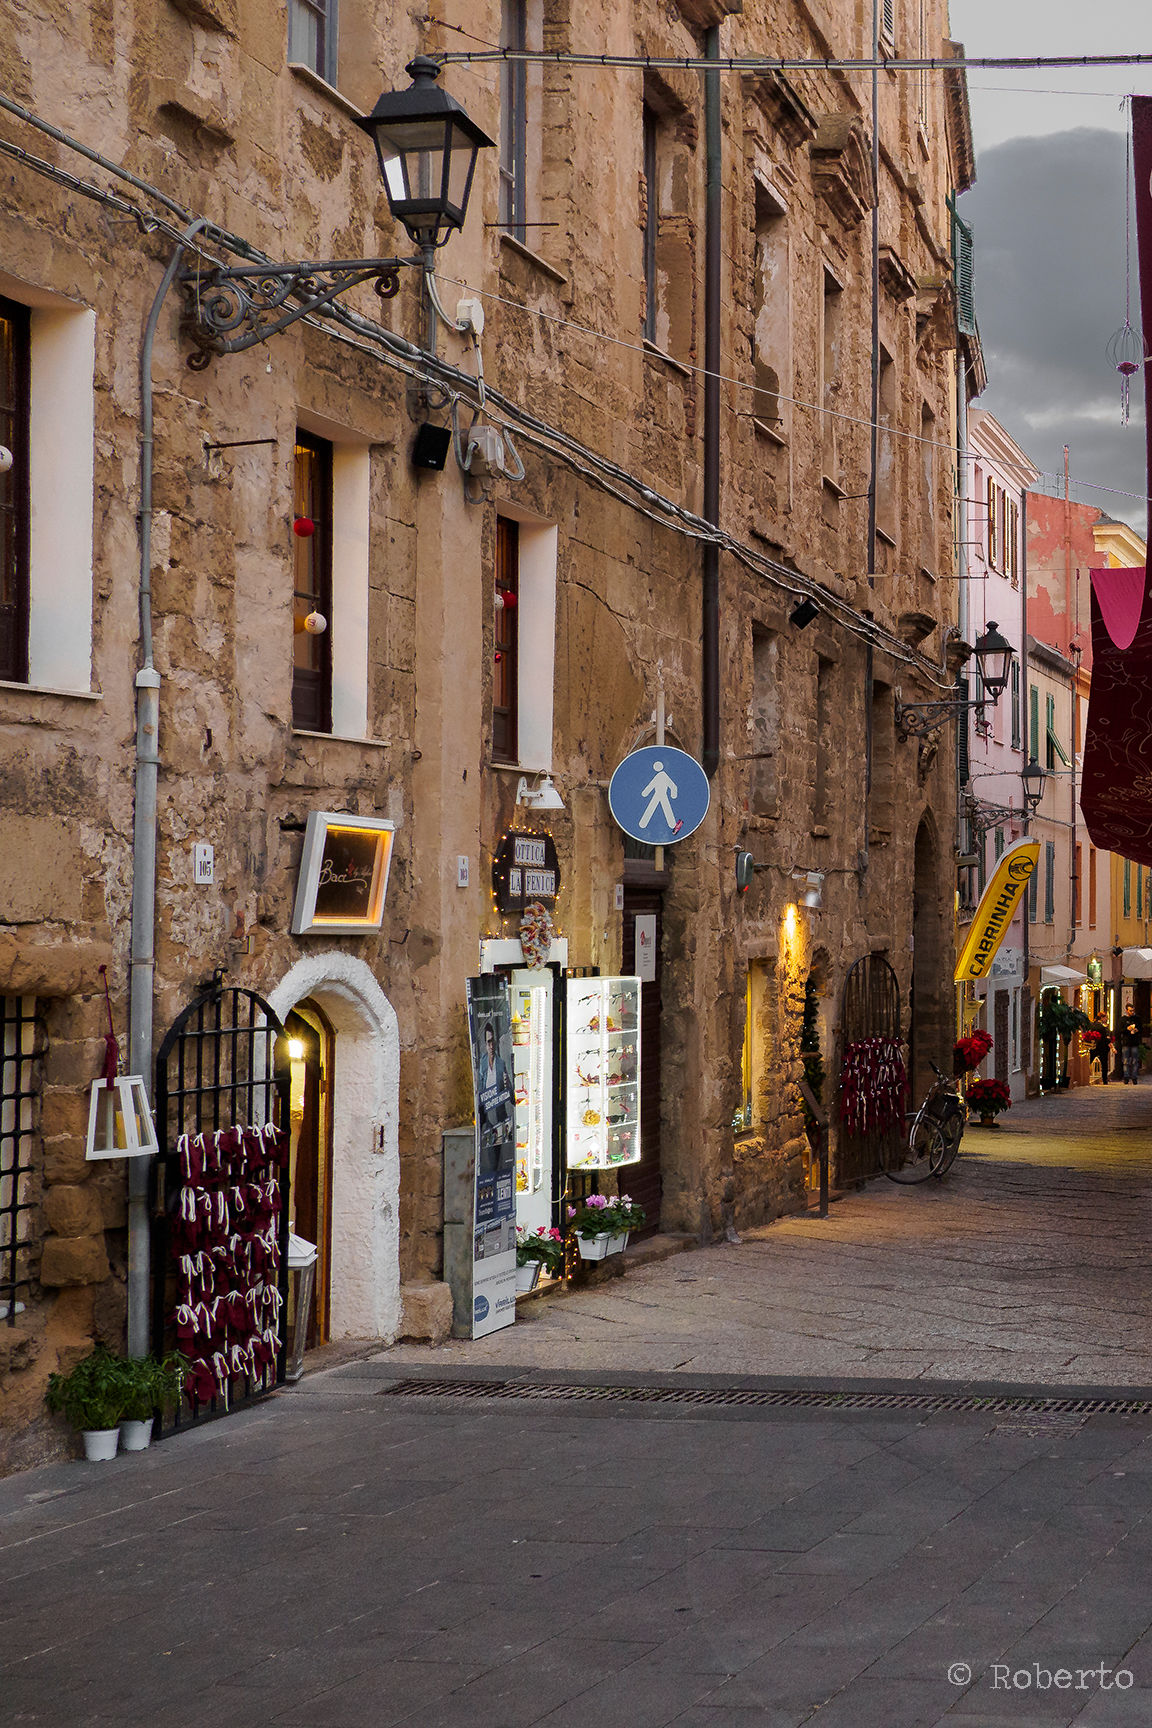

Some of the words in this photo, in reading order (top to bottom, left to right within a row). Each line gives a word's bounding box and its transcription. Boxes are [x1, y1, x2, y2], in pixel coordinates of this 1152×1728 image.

[515, 843, 546, 863] OTTICA
[199, 860, 212, 877] 105
[511, 873, 522, 891] LA
[526, 874, 555, 893] FENICE
[969, 883, 1020, 977] CABRINHA
